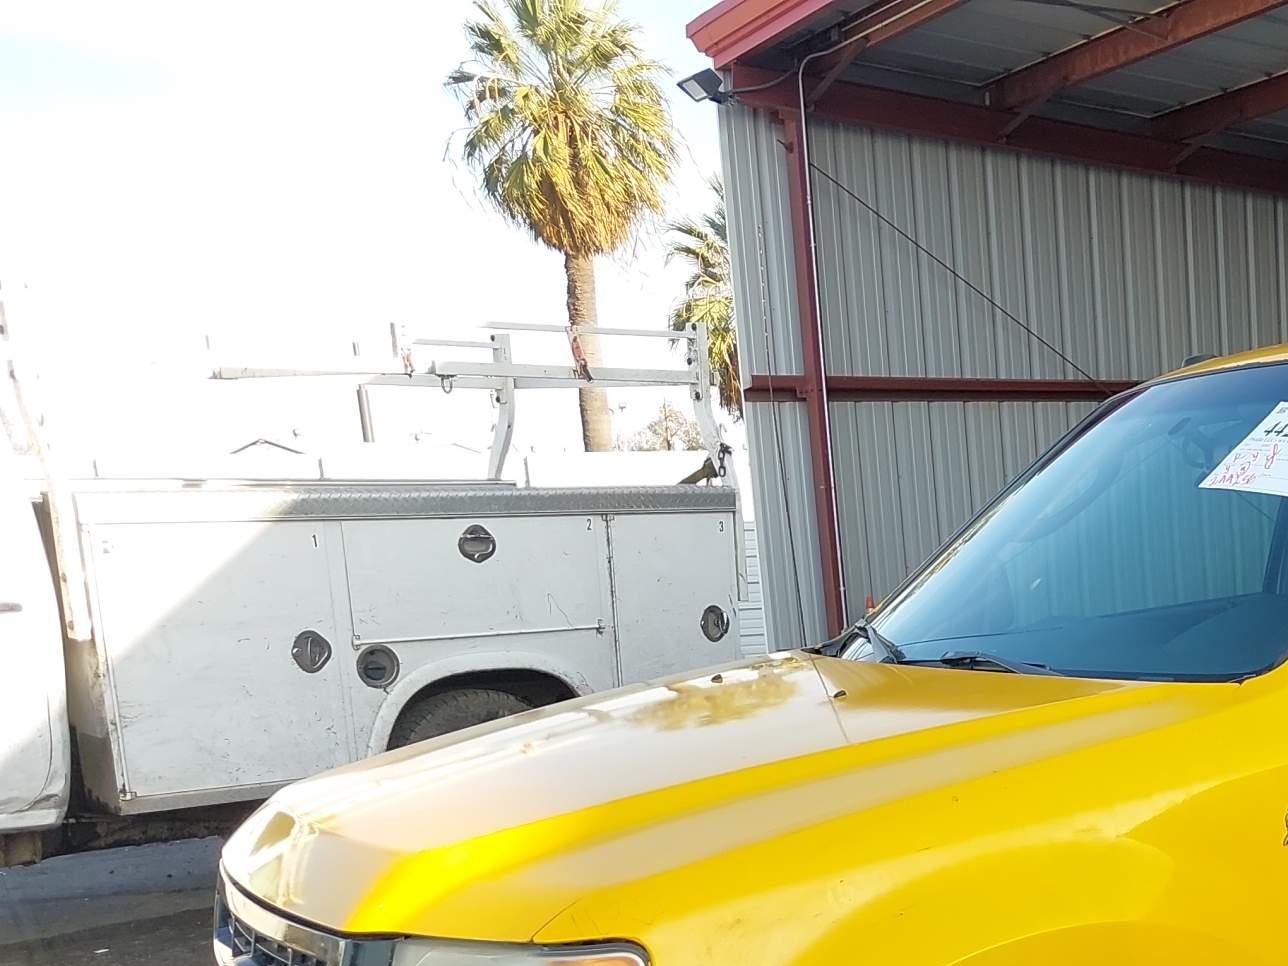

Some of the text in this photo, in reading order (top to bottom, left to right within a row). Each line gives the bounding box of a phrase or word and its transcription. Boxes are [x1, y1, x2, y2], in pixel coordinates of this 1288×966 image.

[586, 518, 593, 531] 2
[719, 520, 725, 532] 3
[311, 533, 318, 548] 1
